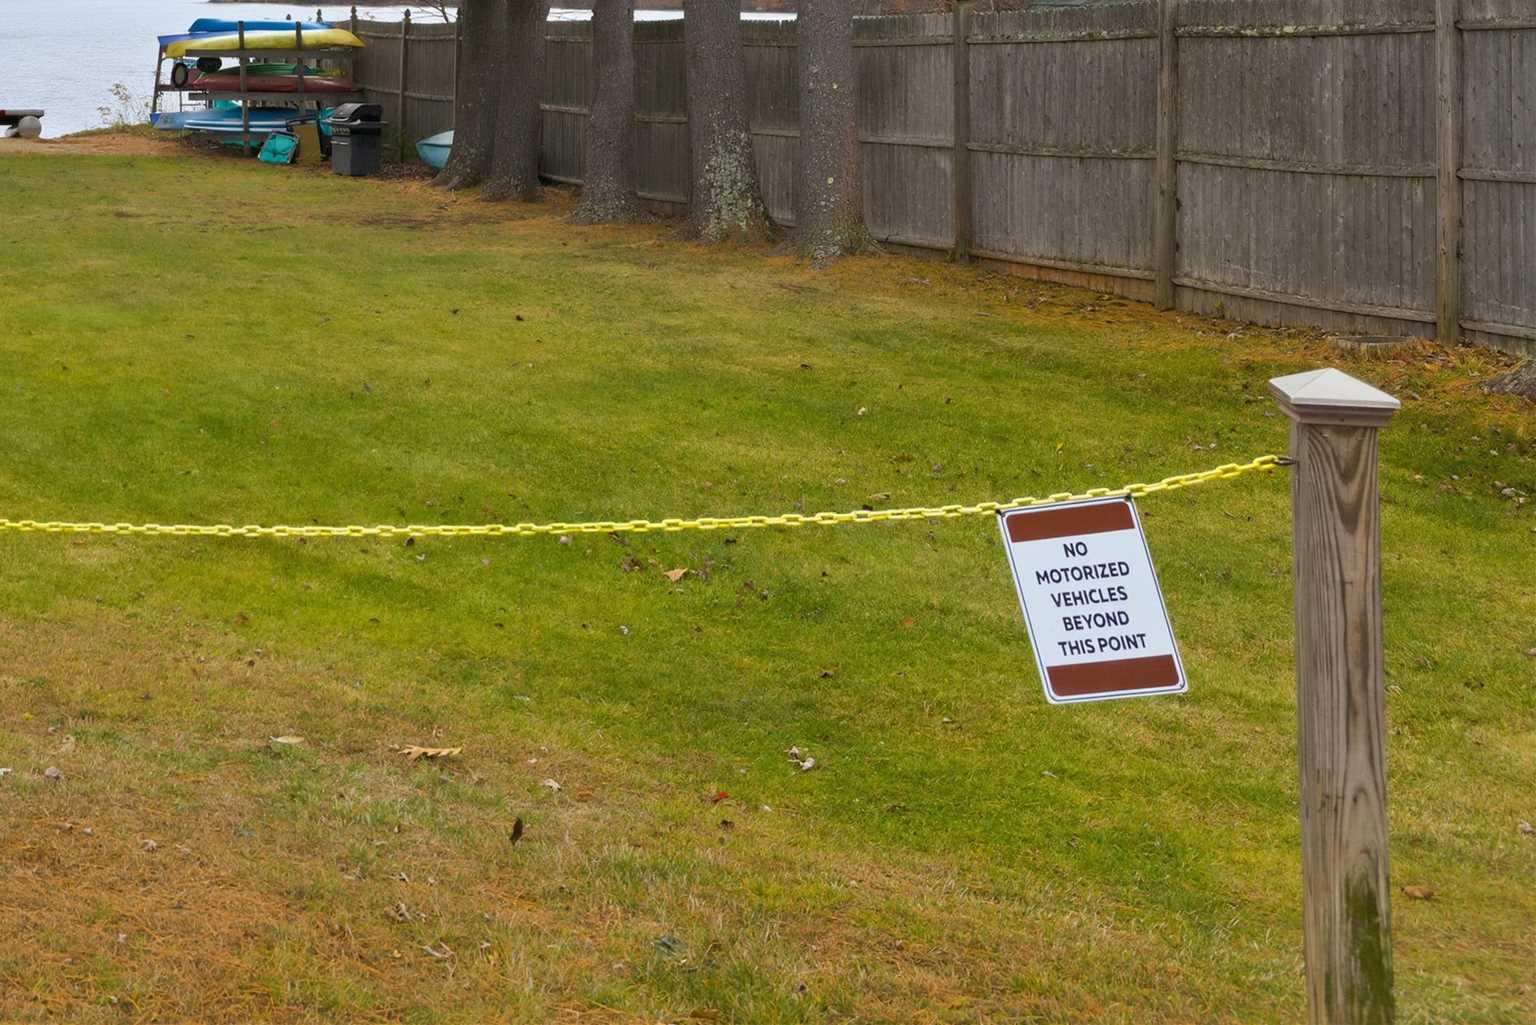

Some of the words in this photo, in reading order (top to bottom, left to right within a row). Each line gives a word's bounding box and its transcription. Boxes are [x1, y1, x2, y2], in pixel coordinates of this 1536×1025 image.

[1063, 542, 1088, 558] NO
[1035, 561, 1130, 585] MOTORIZED
[1050, 586, 1129, 608] VEHICLES
[1062, 610, 1130, 632] BEYOND
[1058, 639, 1095, 656] THIS
[1098, 633, 1146, 653] POINT
